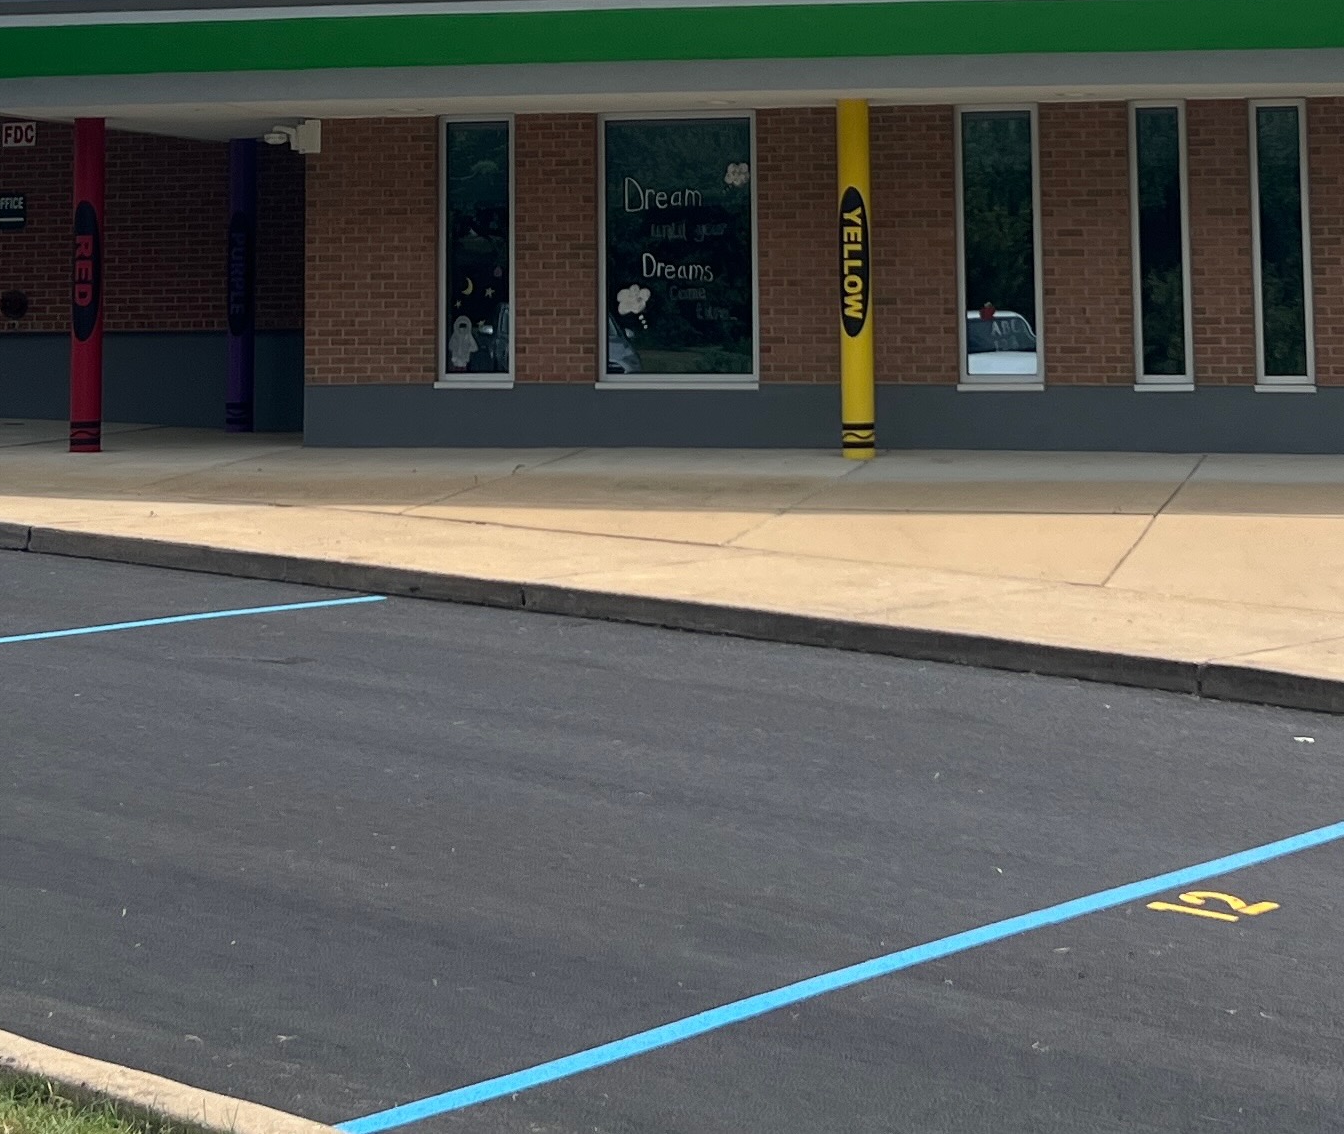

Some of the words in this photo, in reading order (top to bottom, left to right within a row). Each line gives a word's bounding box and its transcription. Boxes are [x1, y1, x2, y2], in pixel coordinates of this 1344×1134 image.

[4, 124, 35, 145] FDC
[625, 177, 703, 213] Dream
[74, 235, 94, 307] RED
[230, 232, 246, 315] PURPLE
[642, 252, 714, 282] Dreams
[842, 206, 864, 320] YELLOW
[1146, 891, 1281, 922] 12
